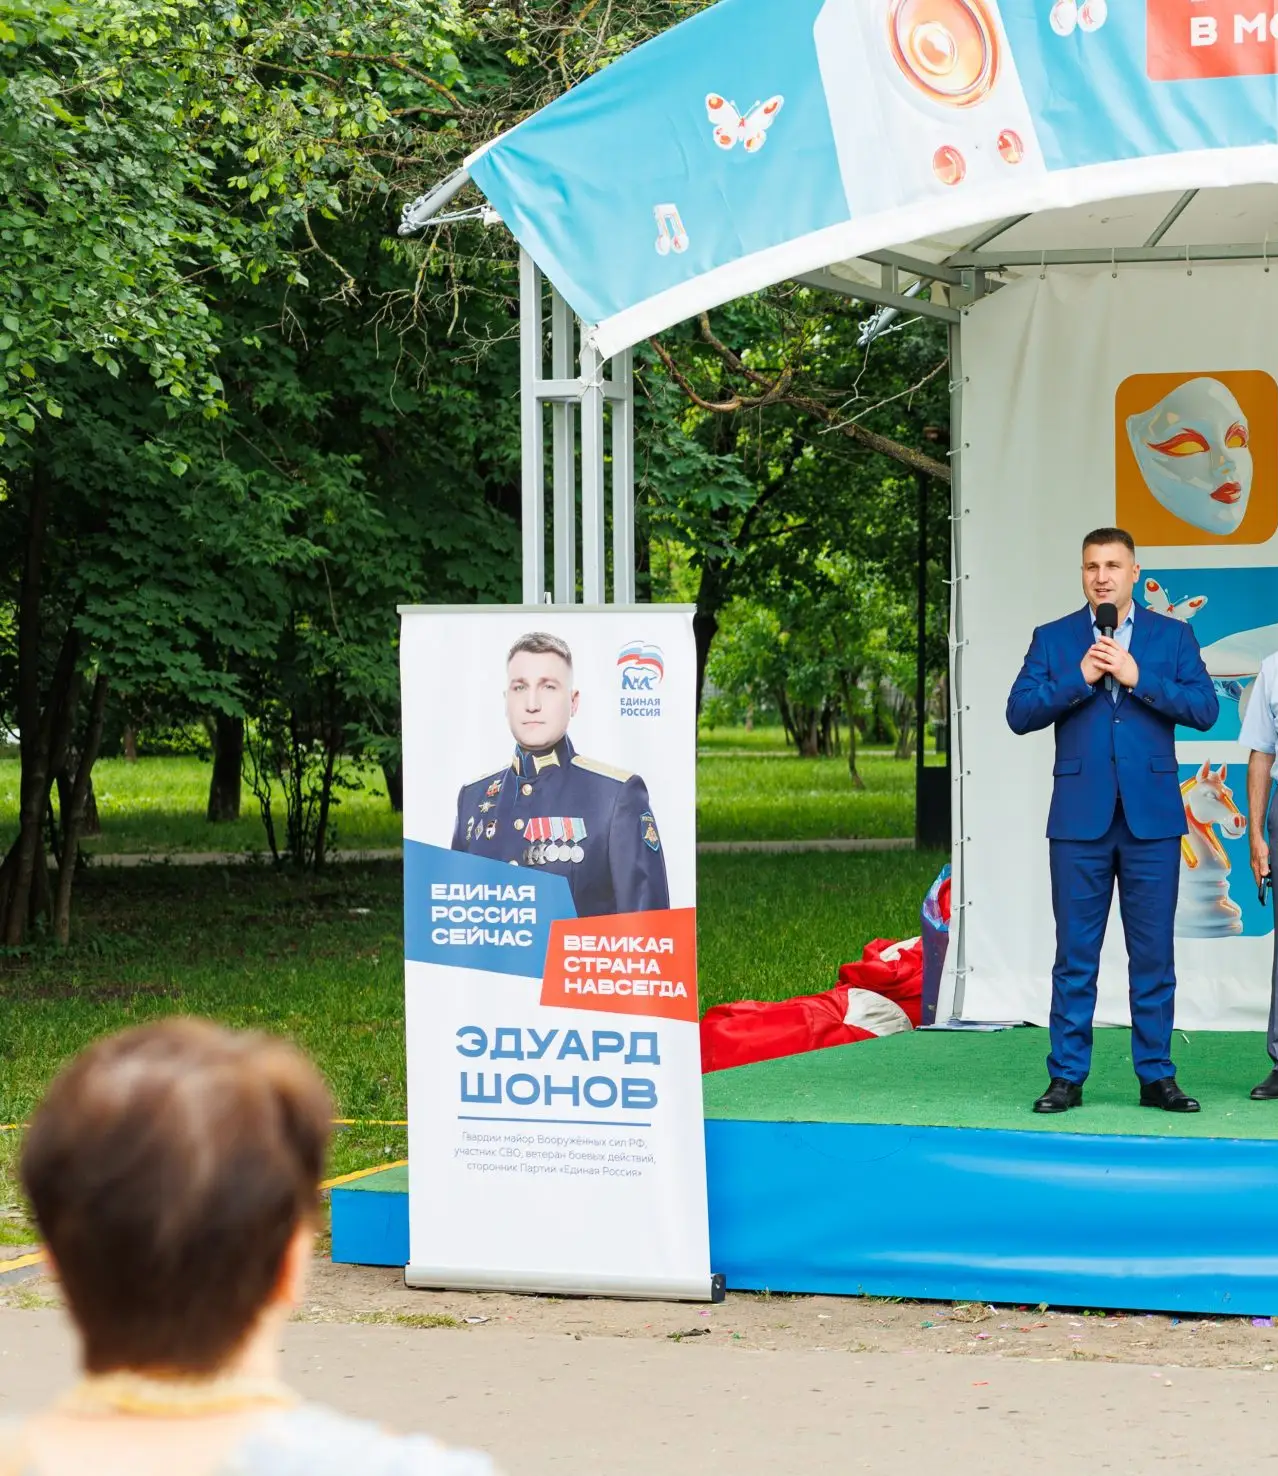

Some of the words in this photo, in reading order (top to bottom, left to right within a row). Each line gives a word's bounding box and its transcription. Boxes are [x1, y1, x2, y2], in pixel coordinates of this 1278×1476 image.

[1190, 17, 1218, 47] В
[620, 697, 661, 707] ЕДИНАЯ
[620, 708, 661, 717] РОССИЯ
[431, 883, 536, 902] ЕДИНАЯ
[431, 907, 537, 925] РОССИЯ
[431, 927, 534, 947] СЕЙЧАС
[563, 935, 674, 954] ВЕЛИКАЯ
[563, 956, 661, 975] СТРАНА
[564, 979, 687, 998] НАВСЕГДА
[455, 1025, 661, 1065] ЭДУАРД
[461, 1072, 658, 1109] ШОНОВ
[462, 1131, 502, 1144] Гвардии
[504, 1133, 535, 1145] майор
[537, 1134, 606, 1148] Вооружённых
[608, 1138, 627, 1148] сил
[453, 1147, 498, 1158] участник
[525, 1150, 566, 1161] ветеран
[568, 1149, 605, 1161] боевых
[466, 1162, 518, 1173] сторонник
[520, 1163, 556, 1175] Партии
[560, 1164, 600, 1176] «Единая
[602, 1166, 642, 1178] Россия»
